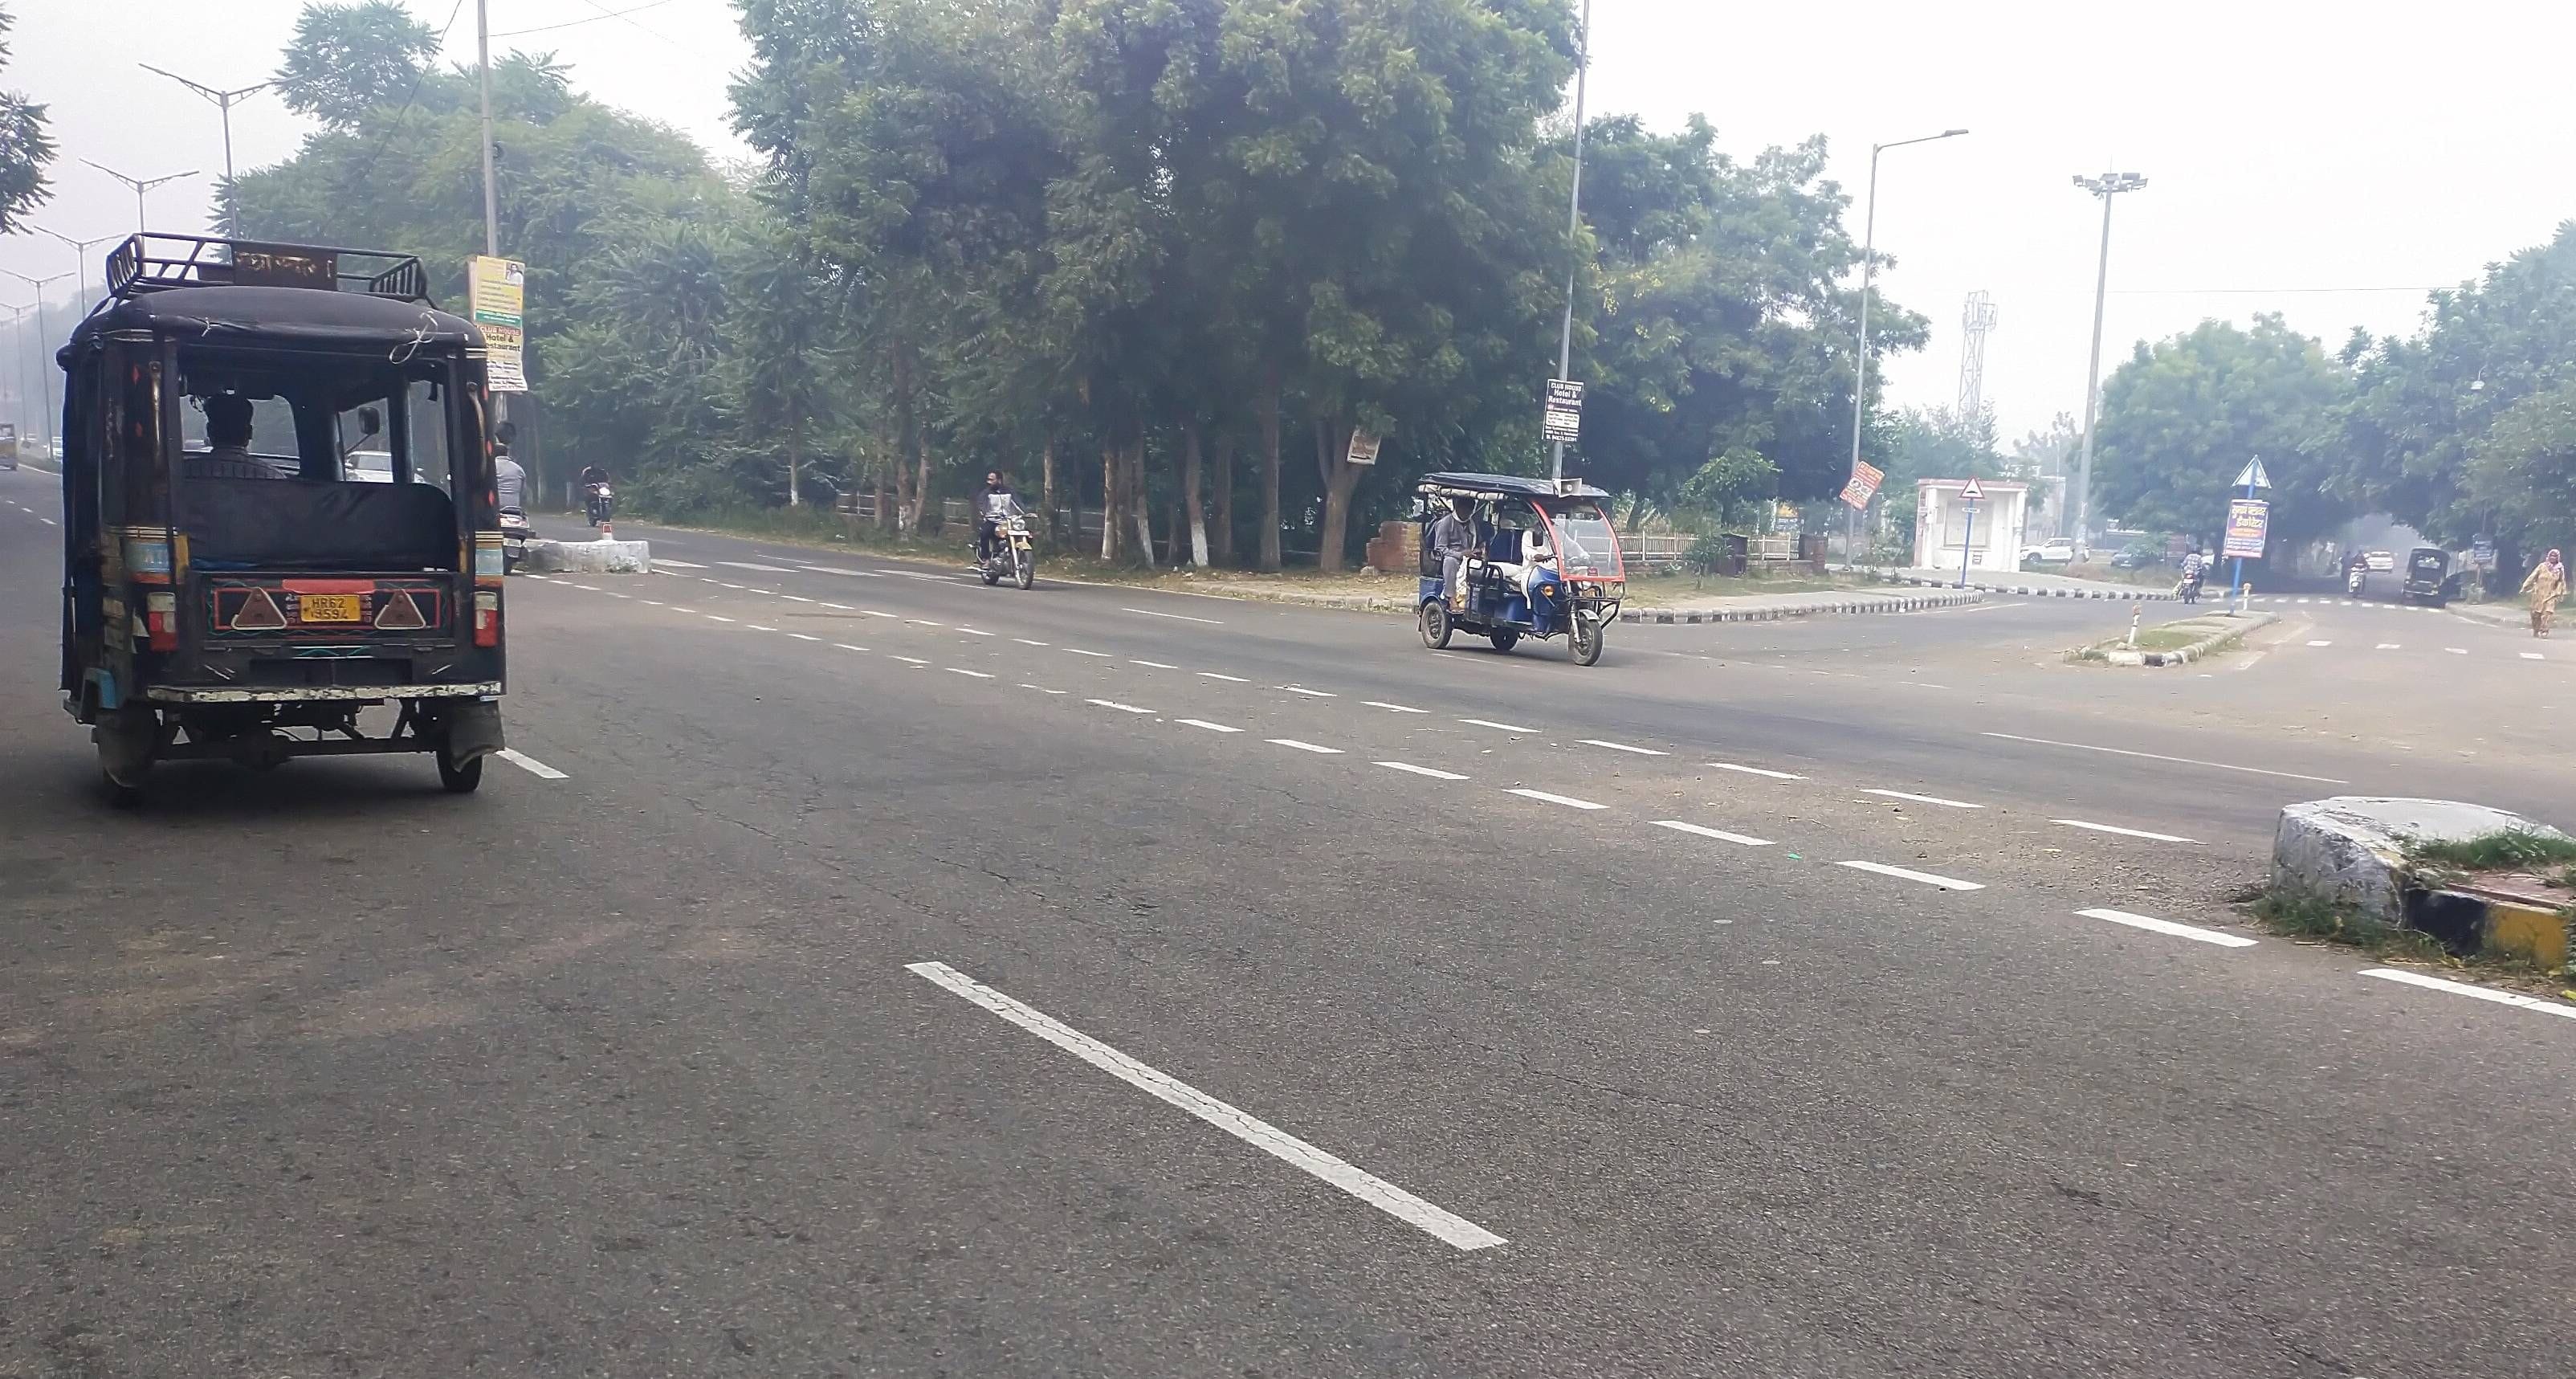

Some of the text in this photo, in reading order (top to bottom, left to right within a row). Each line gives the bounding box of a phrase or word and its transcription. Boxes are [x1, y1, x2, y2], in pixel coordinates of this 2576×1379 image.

[486, 333, 514, 343] Hotel &
[486, 343, 521, 352] estaurant
[1548, 396, 1582, 406] Restaurant
